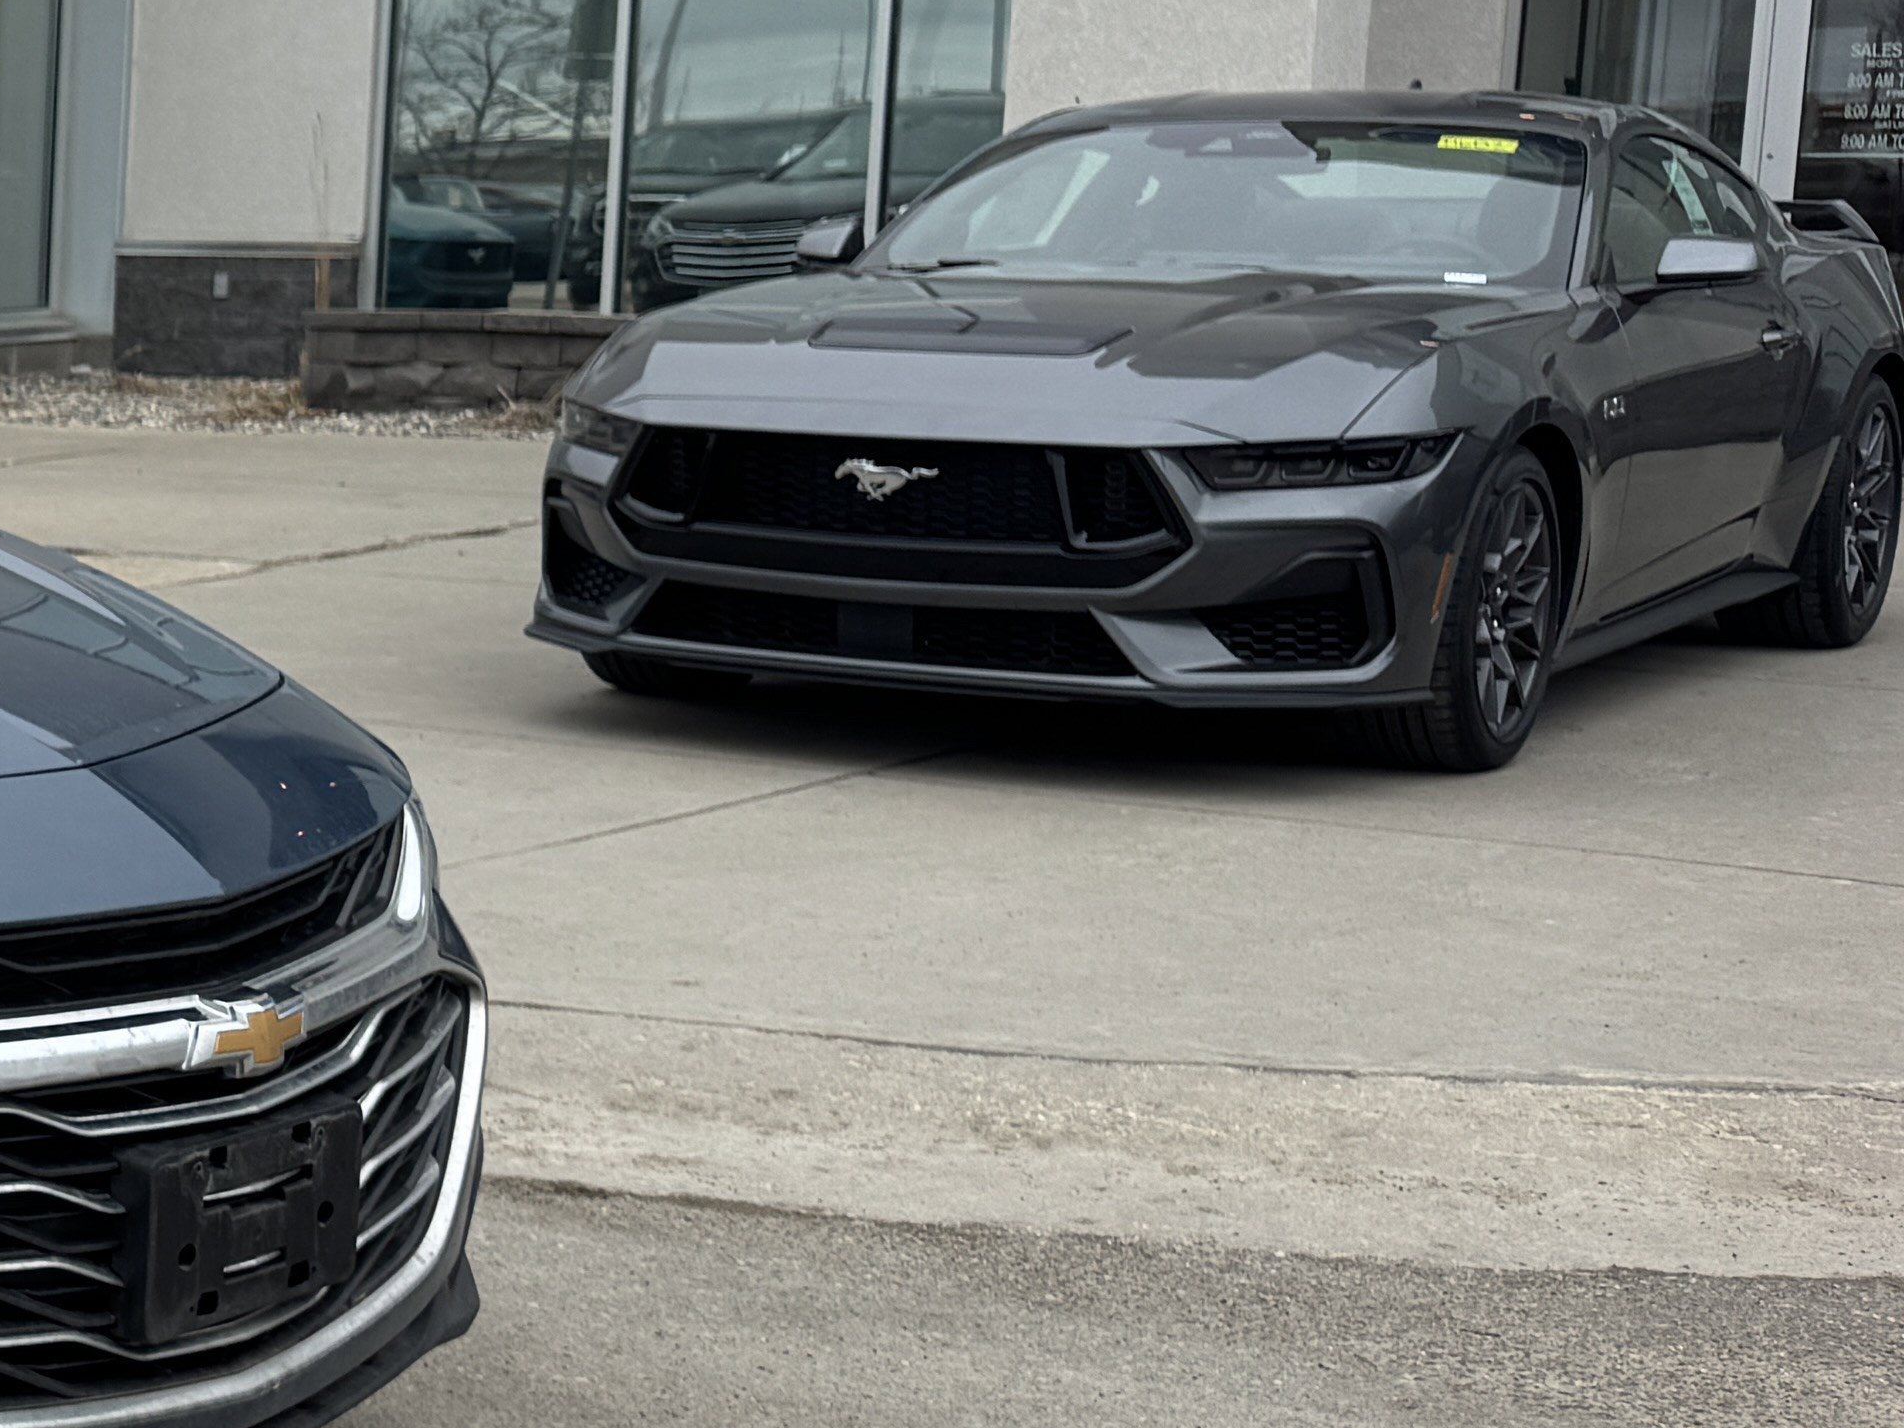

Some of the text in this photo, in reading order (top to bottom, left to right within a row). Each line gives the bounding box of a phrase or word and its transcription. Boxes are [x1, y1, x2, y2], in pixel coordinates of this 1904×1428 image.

[1851, 42, 1902, 58] SALES
[1875, 72, 1894, 89] AM
[1871, 103, 1891, 120] AM
[1868, 133, 1888, 150] AM
